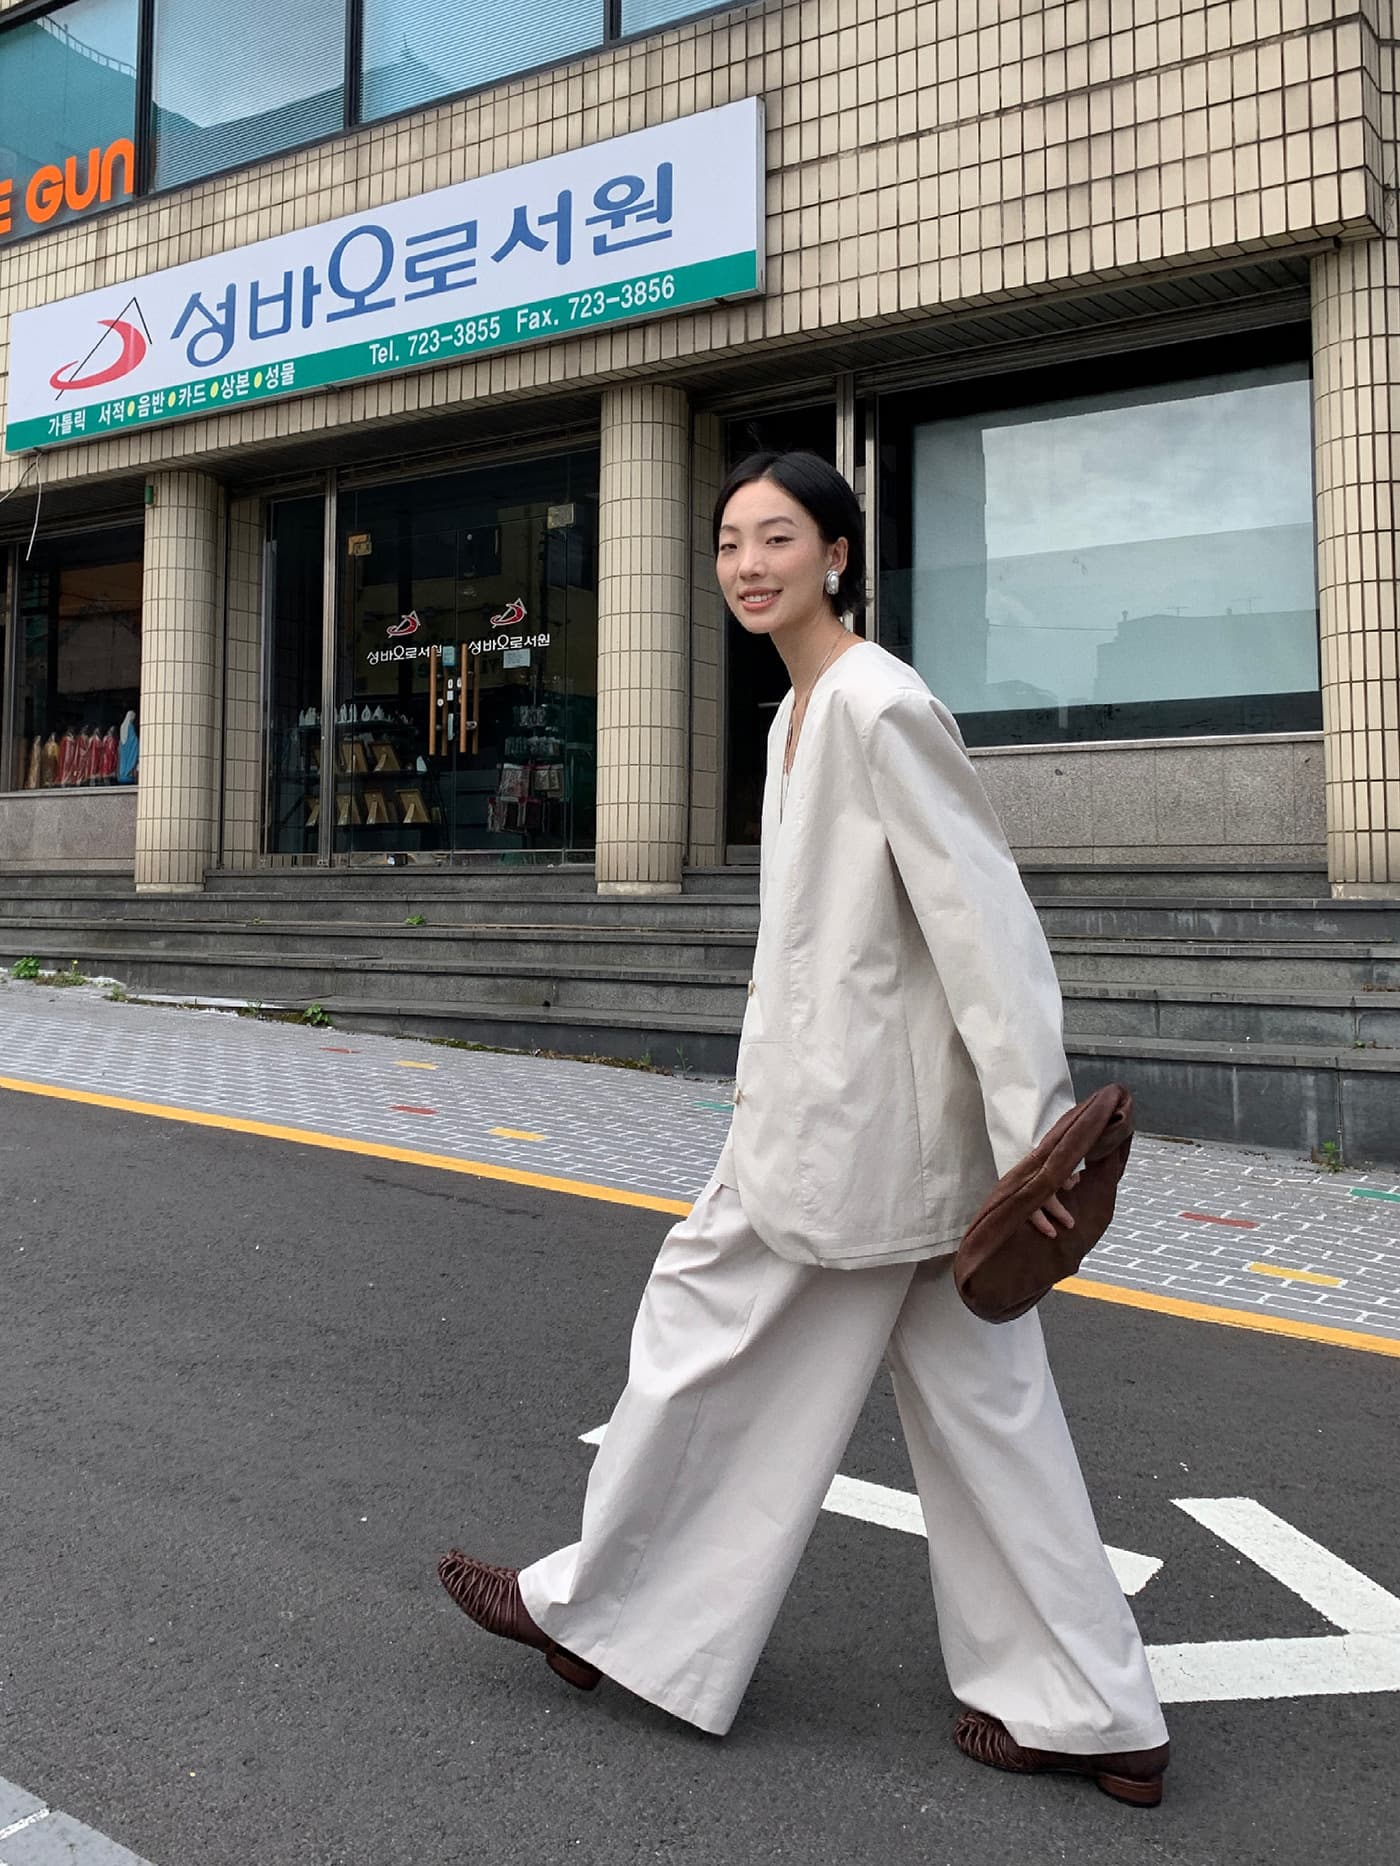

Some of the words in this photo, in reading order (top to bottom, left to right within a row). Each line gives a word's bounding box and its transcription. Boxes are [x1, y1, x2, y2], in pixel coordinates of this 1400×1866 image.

[25, 138, 134, 223] GUN
[170, 161, 673, 367] 성바오로서원
[369, 343, 400, 365] Tel.
[408, 316, 500, 356] 723-3855
[516, 308, 559, 333] Fax.
[568, 274, 675, 320] 723-3856
[48, 409, 86, 437] 가톨릭
[99, 401, 125, 426] 서적
[137, 391, 165, 418] 음반
[178, 384, 207, 407] 카드
[265, 361, 296, 390] 성물
[468, 633, 550, 656] 성바오로서원
